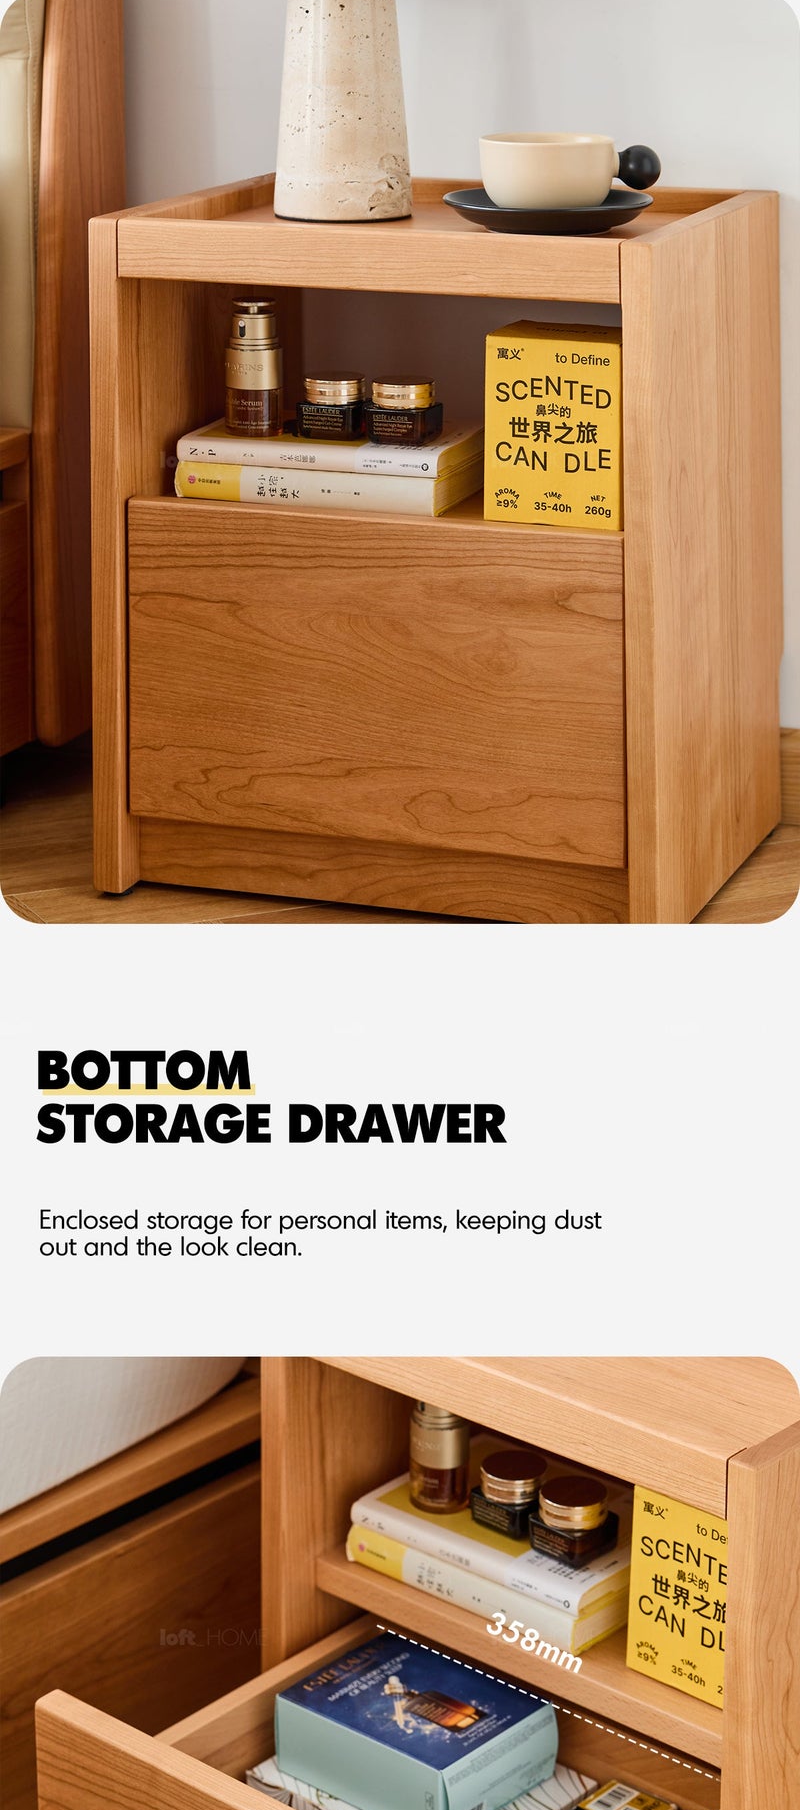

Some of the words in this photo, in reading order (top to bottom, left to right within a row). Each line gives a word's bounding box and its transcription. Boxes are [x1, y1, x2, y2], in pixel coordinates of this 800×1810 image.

[555, 353, 567, 364] to
[572, 353, 610, 366] Define
[495, 375, 612, 409] SCENTED
[536, 403, 571, 418] 鼻尖的
[509, 417, 598, 444] 世界之旅
[495, 441, 548, 472] CAN
[564, 448, 612, 473] DLE
[494, 487, 520, 500] AROMA
[544, 491, 562, 500] TIME
[590, 494, 606, 503] NET
[496, 498, 518, 509] ≥9%
[534, 501, 572, 514] 35-40h
[584, 505, 612, 519] 260g
[677, 1570, 709, 1592] 鼻尖的
[639, 1595, 685, 1637] CAN
[671, 1665, 706, 1687] 35-40h
